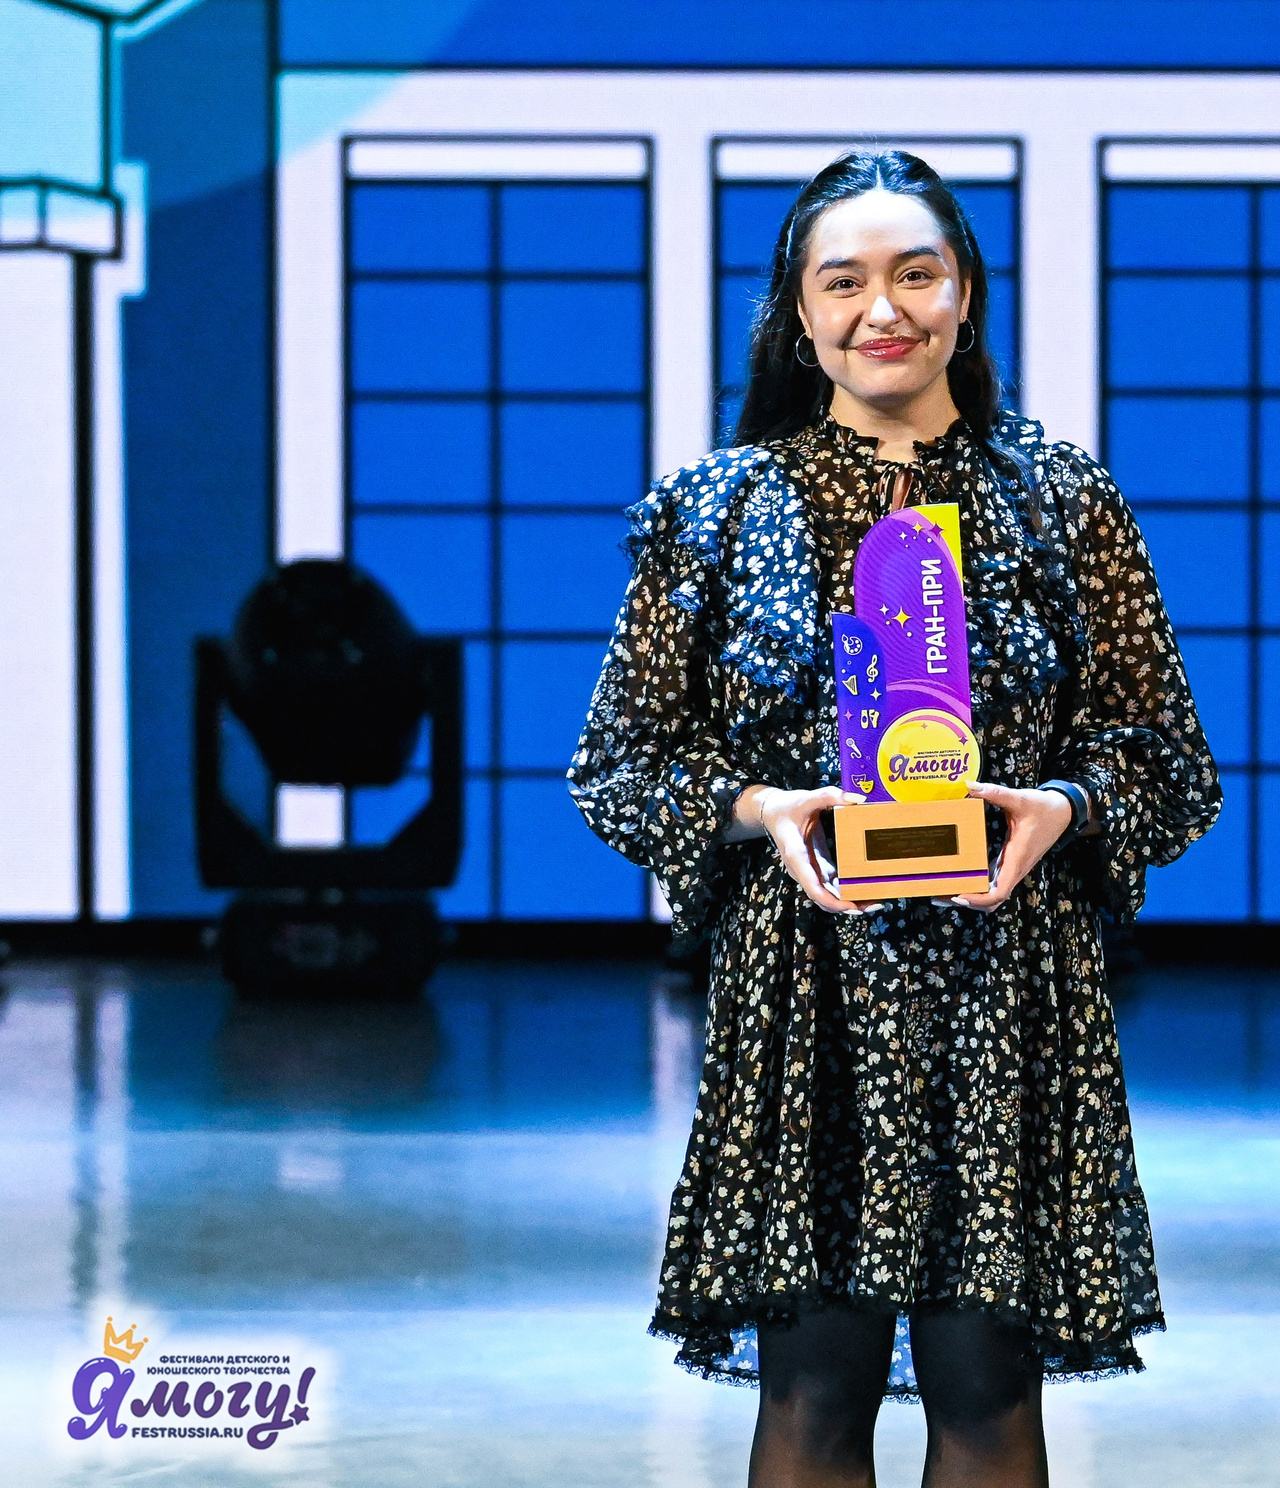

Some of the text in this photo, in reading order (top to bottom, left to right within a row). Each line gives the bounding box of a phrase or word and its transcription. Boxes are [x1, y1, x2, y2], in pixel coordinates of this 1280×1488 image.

[920, 559, 948, 674] ГРАН-ПРИ
[888, 753, 970, 782] Я могу!
